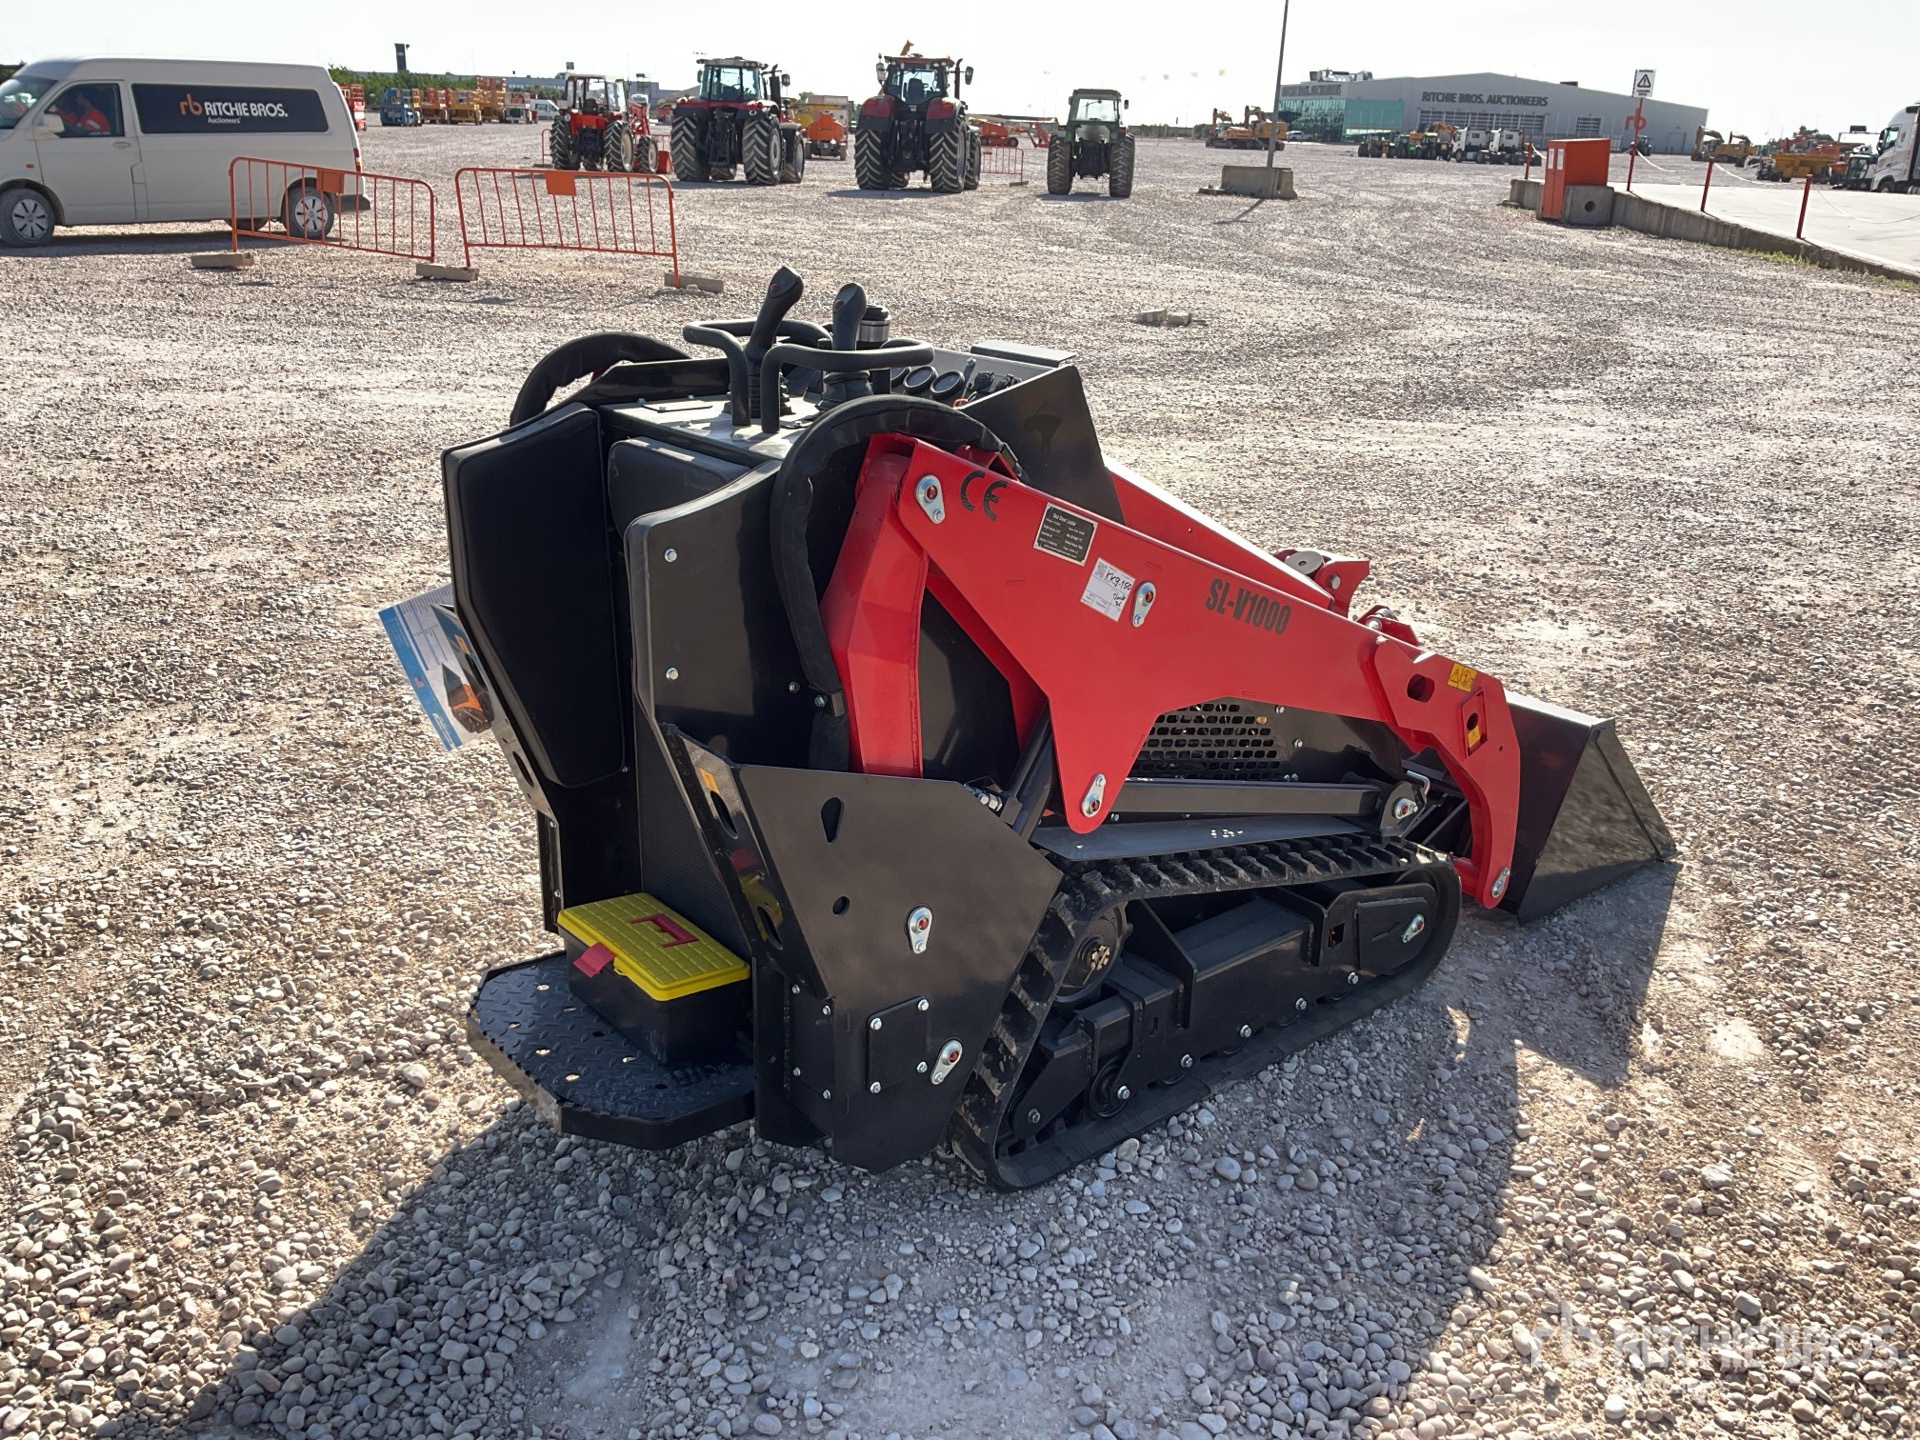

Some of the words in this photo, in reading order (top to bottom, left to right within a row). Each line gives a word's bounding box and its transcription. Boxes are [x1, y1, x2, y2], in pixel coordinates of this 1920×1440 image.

[1421, 91, 1457, 103] RITCHIE
[1458, 93, 1485, 104] BROS.
[1485, 94, 1549, 107] AUCTIONEERS
[204, 101, 249, 116] RITCHIE
[249, 102, 289, 117] BROS.
[1205, 577, 1292, 635] SL-V1000
